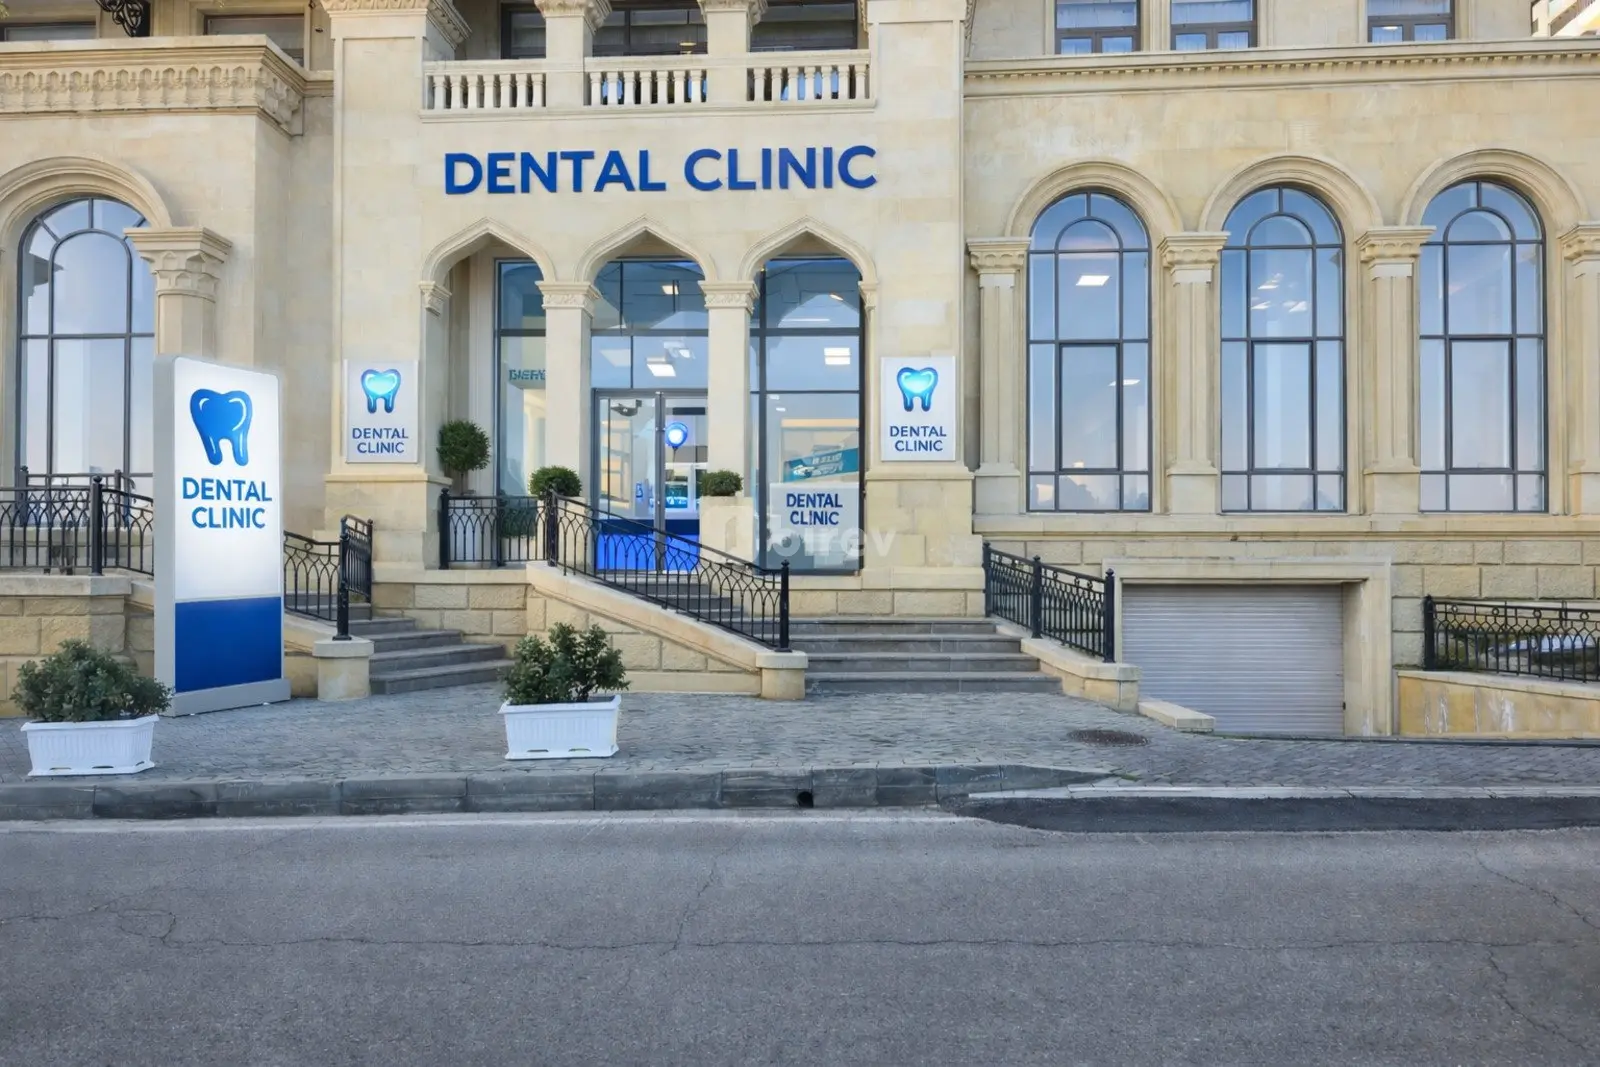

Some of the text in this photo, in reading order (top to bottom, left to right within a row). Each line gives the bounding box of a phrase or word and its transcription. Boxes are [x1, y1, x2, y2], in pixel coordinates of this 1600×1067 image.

[445, 145, 877, 195] DENTAL CLINIC
[352, 428, 408, 439] DENTAL
[889, 426, 947, 437] DENTAL
[357, 442, 404, 454] CLINIC
[894, 440, 943, 452] CLINIC
[182, 477, 272, 502] DENTAL
[786, 493, 843, 508] DENTAL
[191, 506, 265, 529] CLINIC
[790, 510, 839, 526] CLINIC
